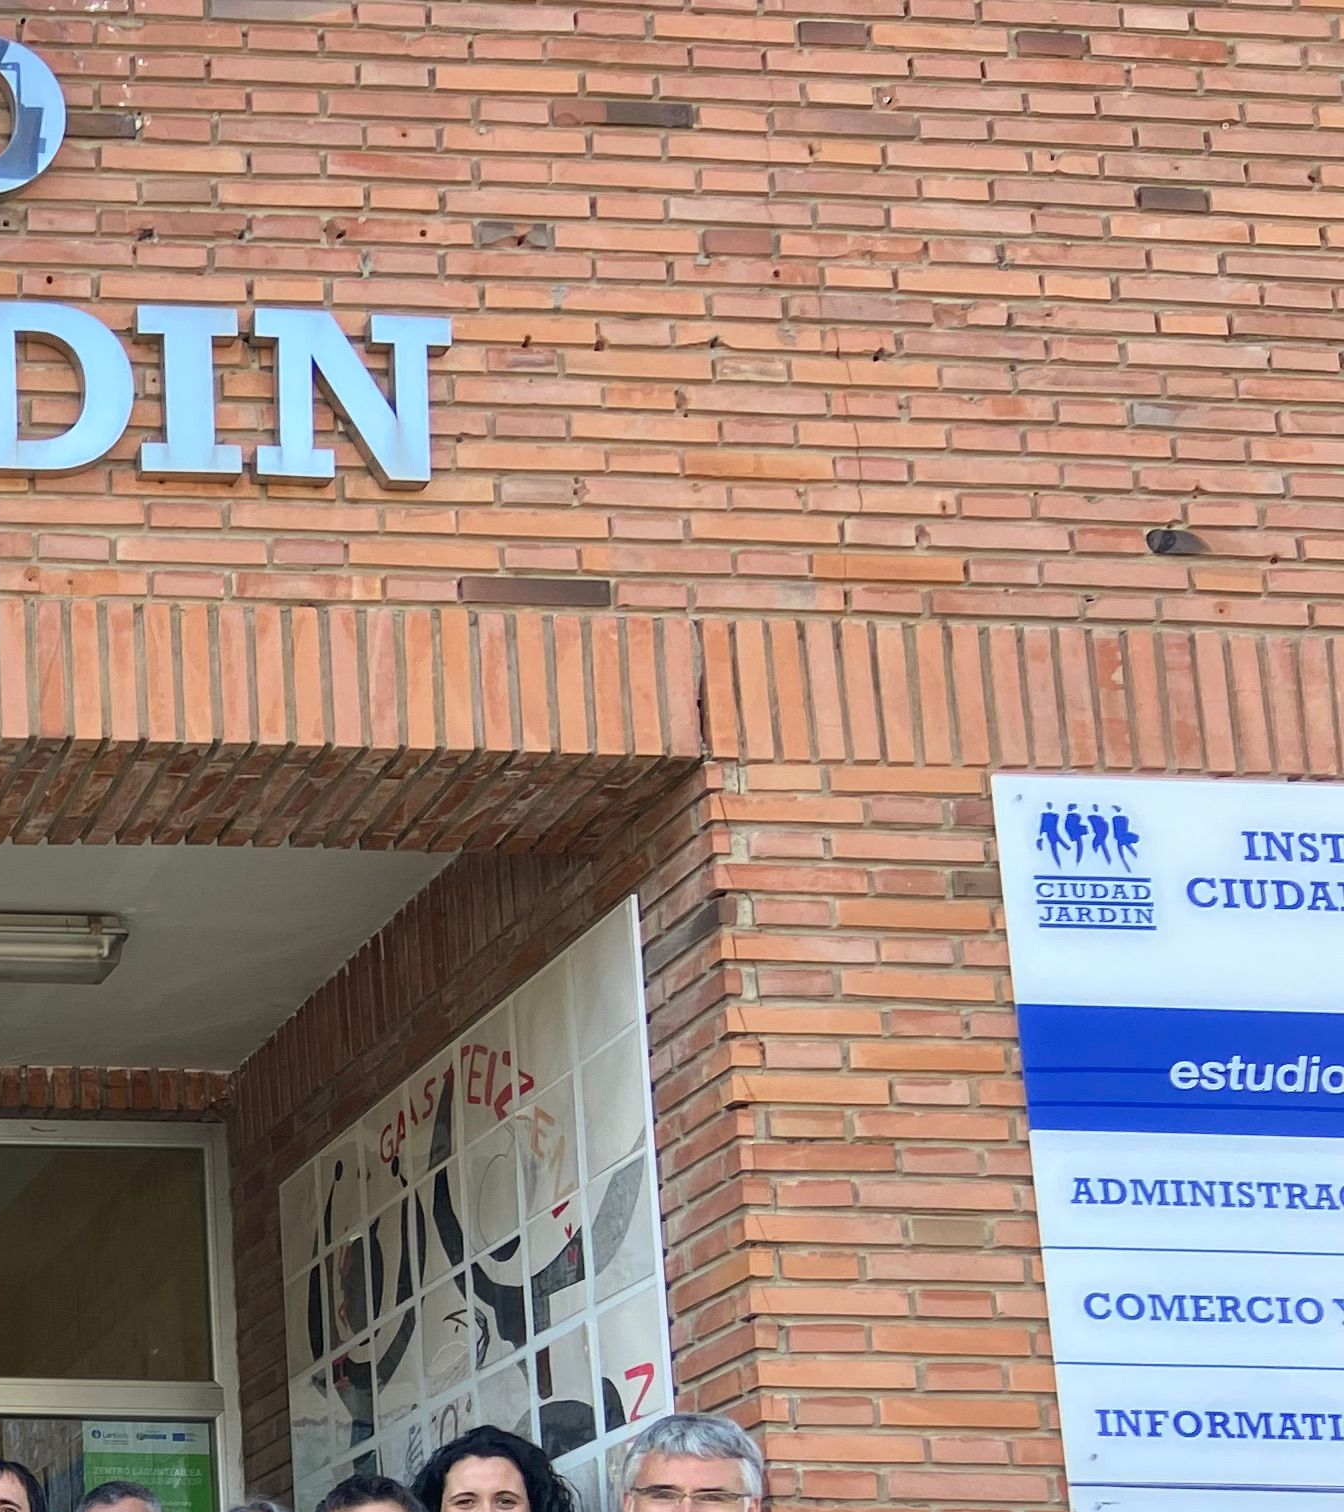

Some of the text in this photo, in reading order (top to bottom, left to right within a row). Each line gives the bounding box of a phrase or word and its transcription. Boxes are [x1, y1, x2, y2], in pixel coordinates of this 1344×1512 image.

[1241, 831, 1344, 863] INST
[1036, 883, 1151, 900] CIUDAD
[1186, 877, 1344, 911] CIUDA
[1039, 906, 1154, 923] JARDIN
[1070, 1177, 1344, 1210] ADMINISTRA
[1083, 1293, 1324, 1325] COMERCIO
